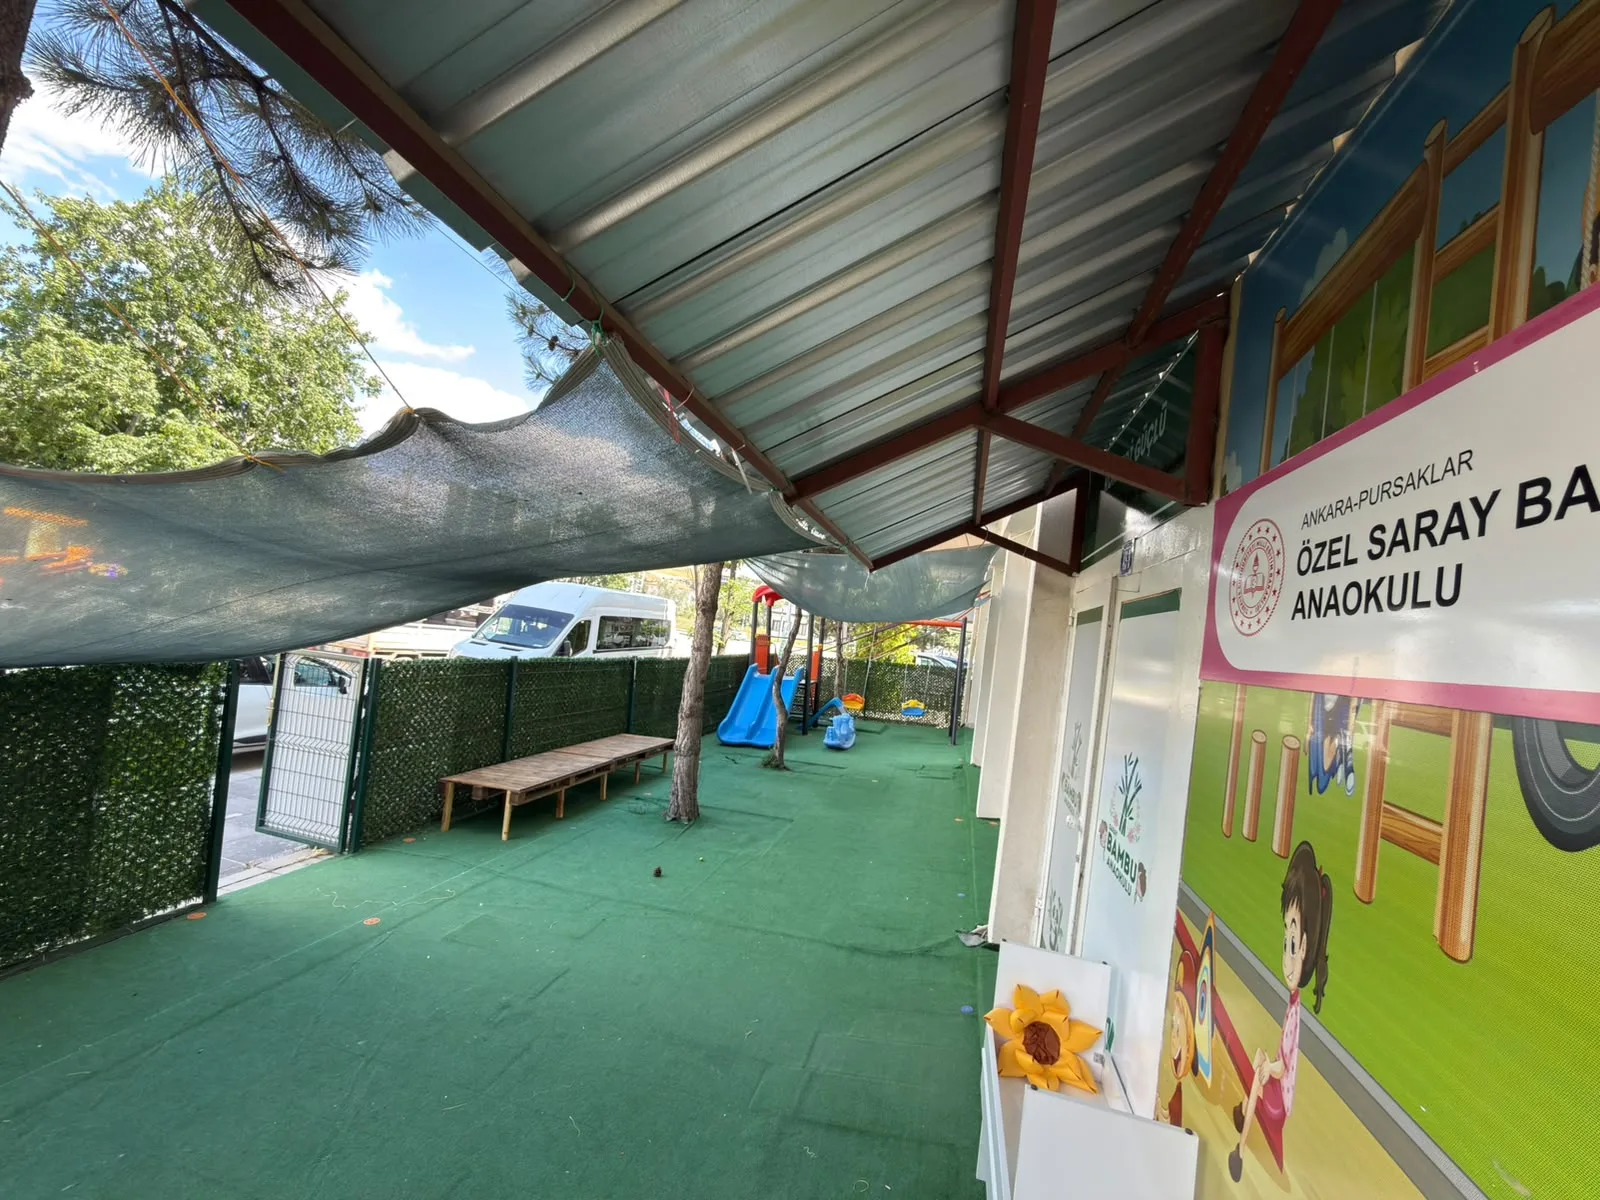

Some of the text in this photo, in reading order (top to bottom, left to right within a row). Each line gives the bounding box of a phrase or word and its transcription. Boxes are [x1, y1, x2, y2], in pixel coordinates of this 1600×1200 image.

[1296, 464, 1600, 576] ÖZEL SARAY BA
[1301, 449, 1473, 530] ANKARA-PURSAKLAR
[1291, 563, 1463, 621] ANAOKULU
[1106, 831, 1137, 884] BAMBU
